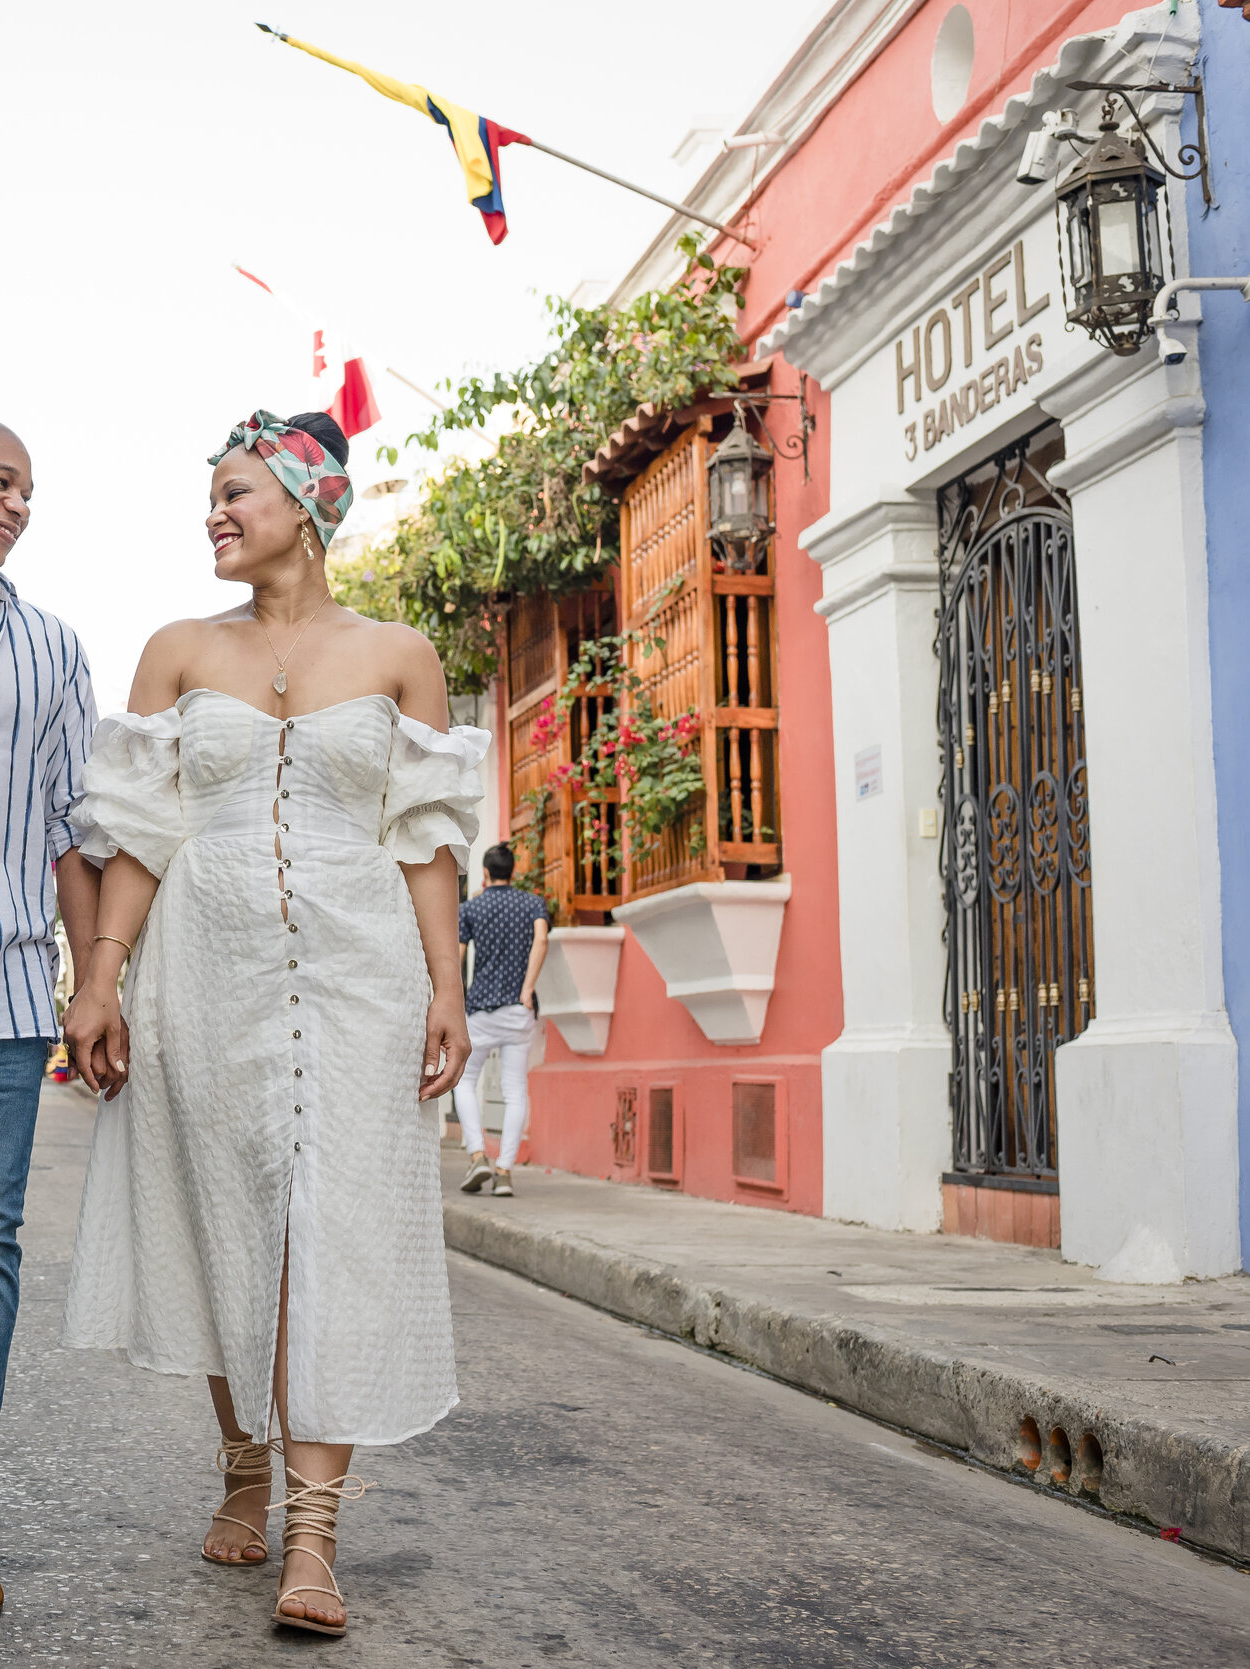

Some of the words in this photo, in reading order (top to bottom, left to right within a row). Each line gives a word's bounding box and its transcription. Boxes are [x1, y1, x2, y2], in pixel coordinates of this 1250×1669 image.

[895, 240, 1050, 414] HOTEL
[905, 421, 918, 461] 3
[923, 333, 1043, 451] BANDERAS
